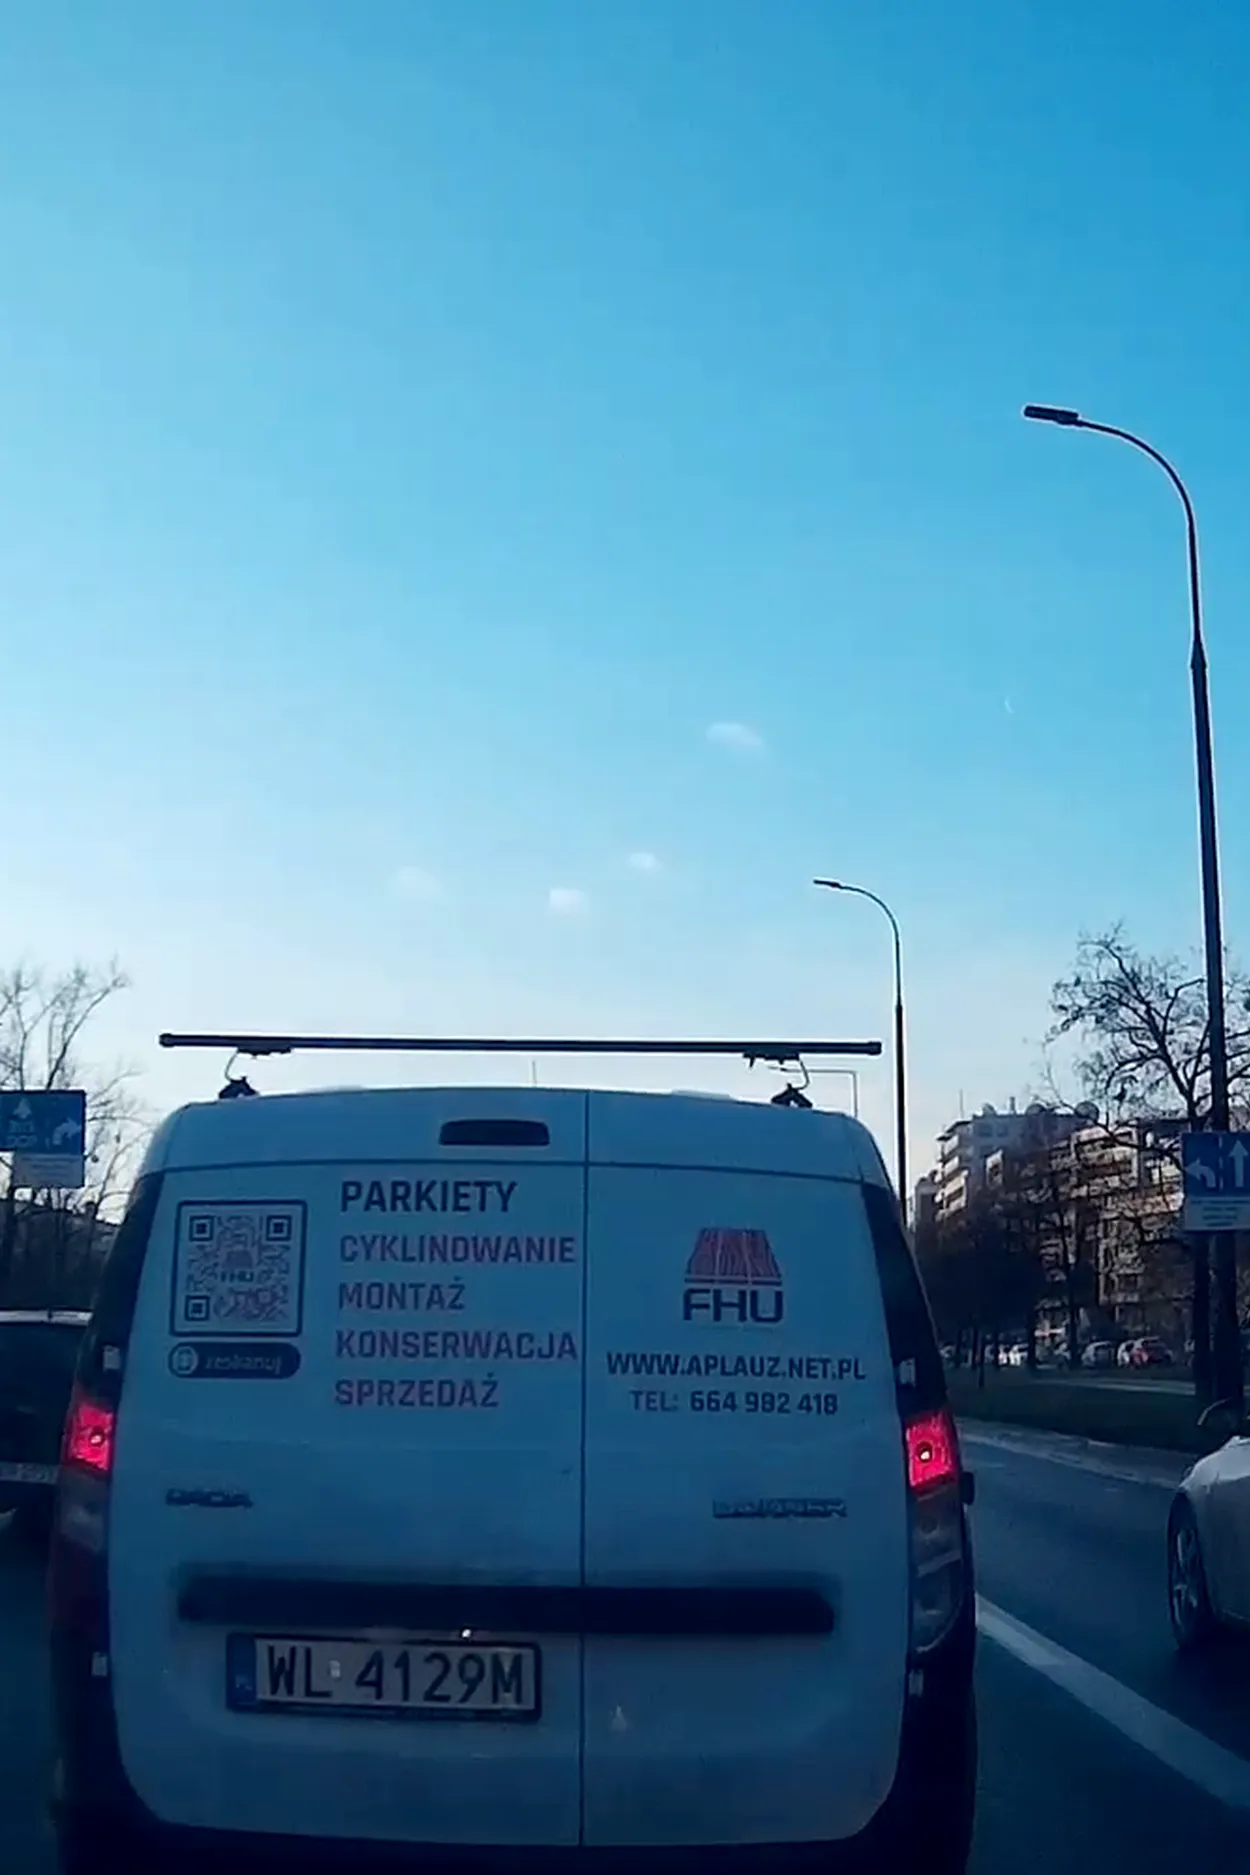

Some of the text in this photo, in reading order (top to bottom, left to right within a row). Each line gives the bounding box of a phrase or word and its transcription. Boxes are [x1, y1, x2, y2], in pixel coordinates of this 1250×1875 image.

[340, 1180, 517, 1213] PARKIETY
[340, 1234, 577, 1263] CYKLINOWANIE
[338, 1275, 466, 1311] MONTAŻ
[683, 1288, 783, 1323] FHU
[335, 1329, 578, 1360] KONSERWACJA
[606, 1351, 866, 1380] WWW.APLAUZ.NET.PL
[334, 1371, 500, 1408] SPRZEDAŻ
[630, 1390, 838, 1416] TEL: 664 982 418
[267, 1645, 524, 1705] WL 4129M
